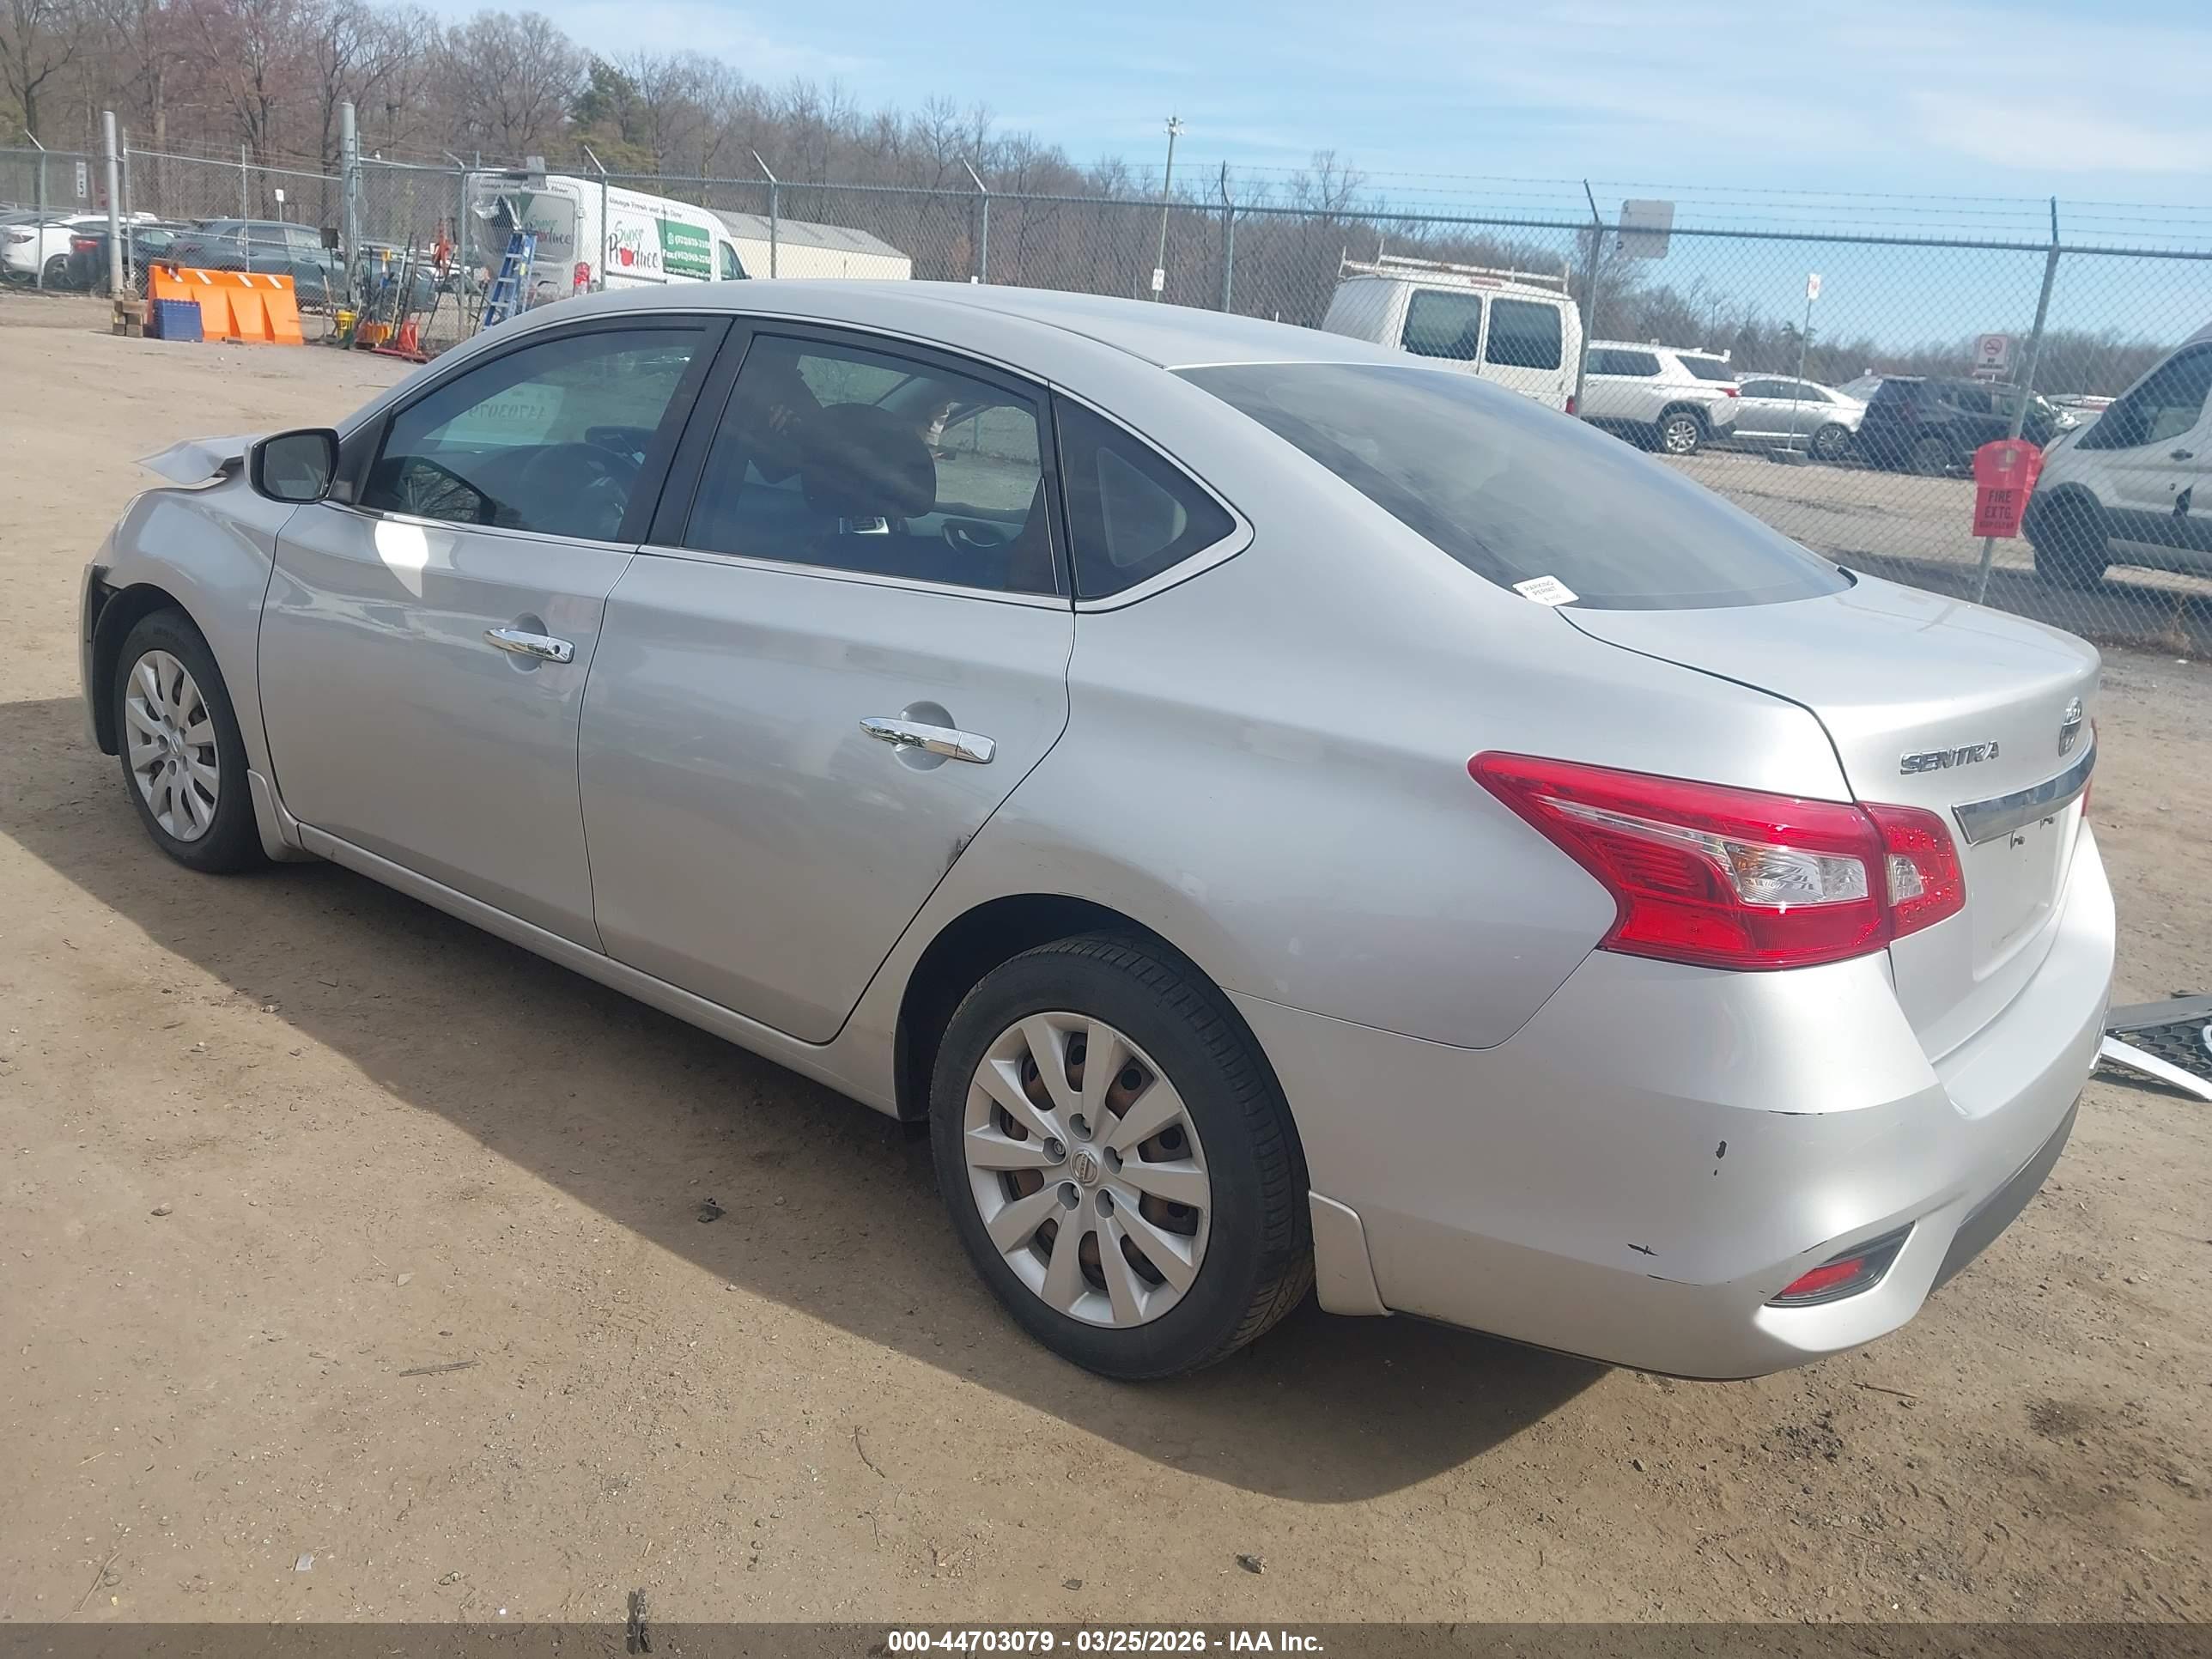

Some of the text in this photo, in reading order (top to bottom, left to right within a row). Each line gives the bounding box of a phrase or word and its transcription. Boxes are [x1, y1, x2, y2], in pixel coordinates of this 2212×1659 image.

[615, 221, 644, 247] Super
[606, 233, 659, 270] Produce
[1988, 489, 2012, 503] FIRE
[1900, 740, 1999, 775] SENTRA
